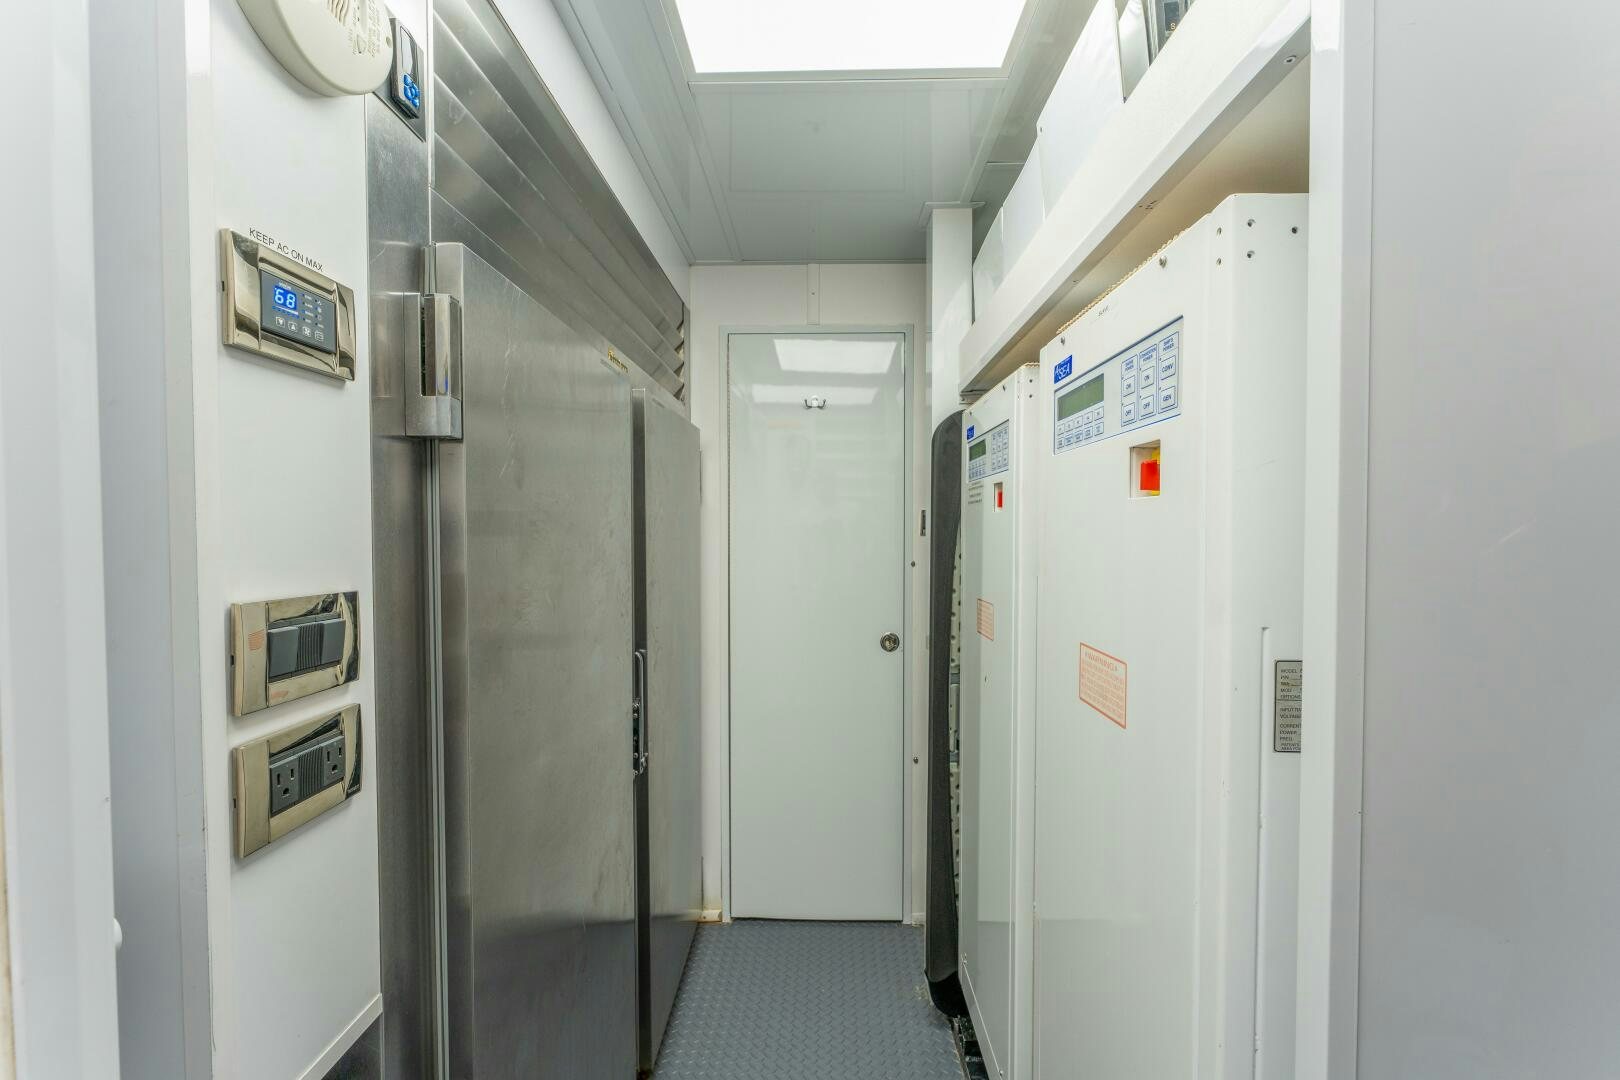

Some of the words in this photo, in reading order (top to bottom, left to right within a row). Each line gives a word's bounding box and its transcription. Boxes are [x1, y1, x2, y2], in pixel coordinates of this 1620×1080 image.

[249, 227, 275, 246] KEEP
[277, 242, 289, 254] AC
[291, 250, 304, 262] ON
[306, 256, 324, 272] MAX
[274, 288, 296, 308] 68
[1162, 362, 1174, 372] CONV
